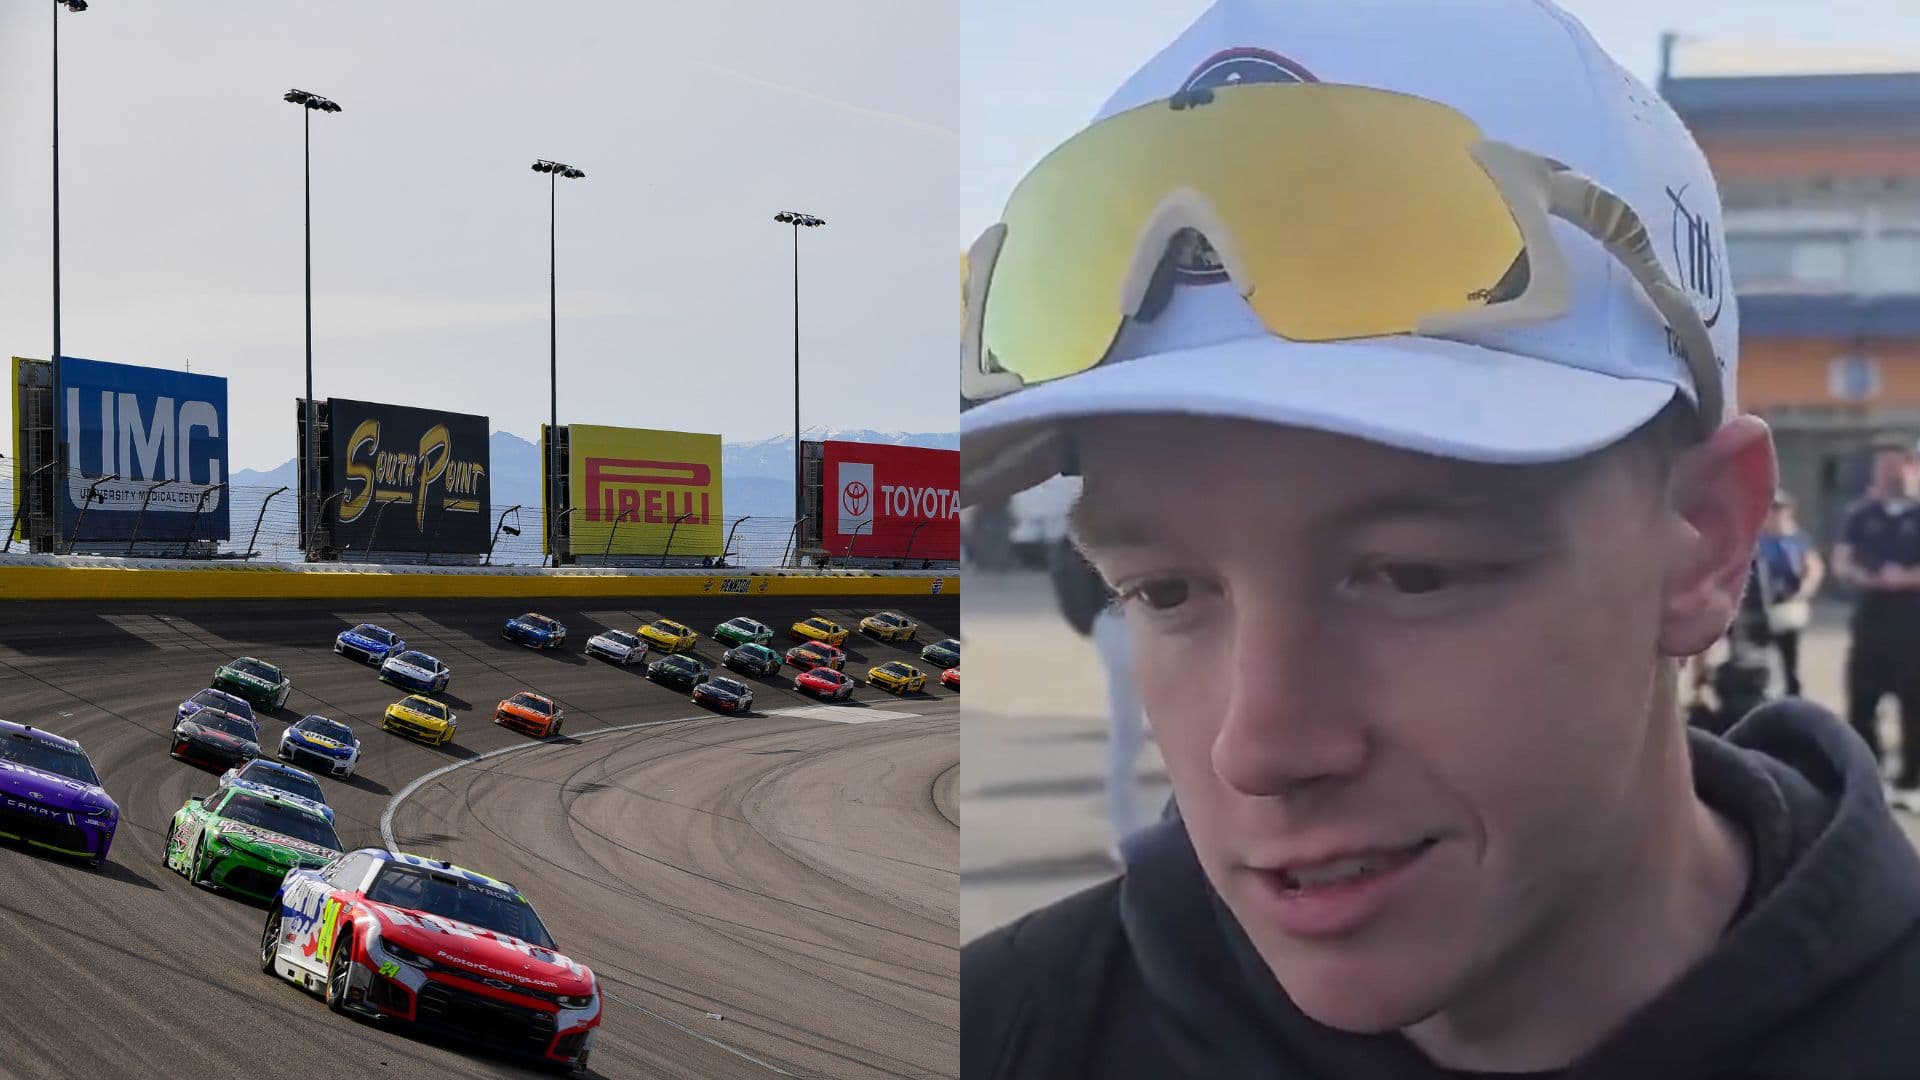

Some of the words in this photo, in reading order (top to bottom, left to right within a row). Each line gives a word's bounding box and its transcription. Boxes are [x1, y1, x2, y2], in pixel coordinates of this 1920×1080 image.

[67, 387, 220, 512] UMC
[80, 488, 136, 500] UVERSITY
[138, 490, 176, 502] MDICAL
[179, 492, 211, 503] CENTR
[585, 457, 711, 525] PIRELLI
[7, 800, 60, 818] CAMRY
[468, 884, 512, 902] BYRON
[378, 962, 401, 978] 24
[437, 950, 558, 988] RaptorCoatings.com
